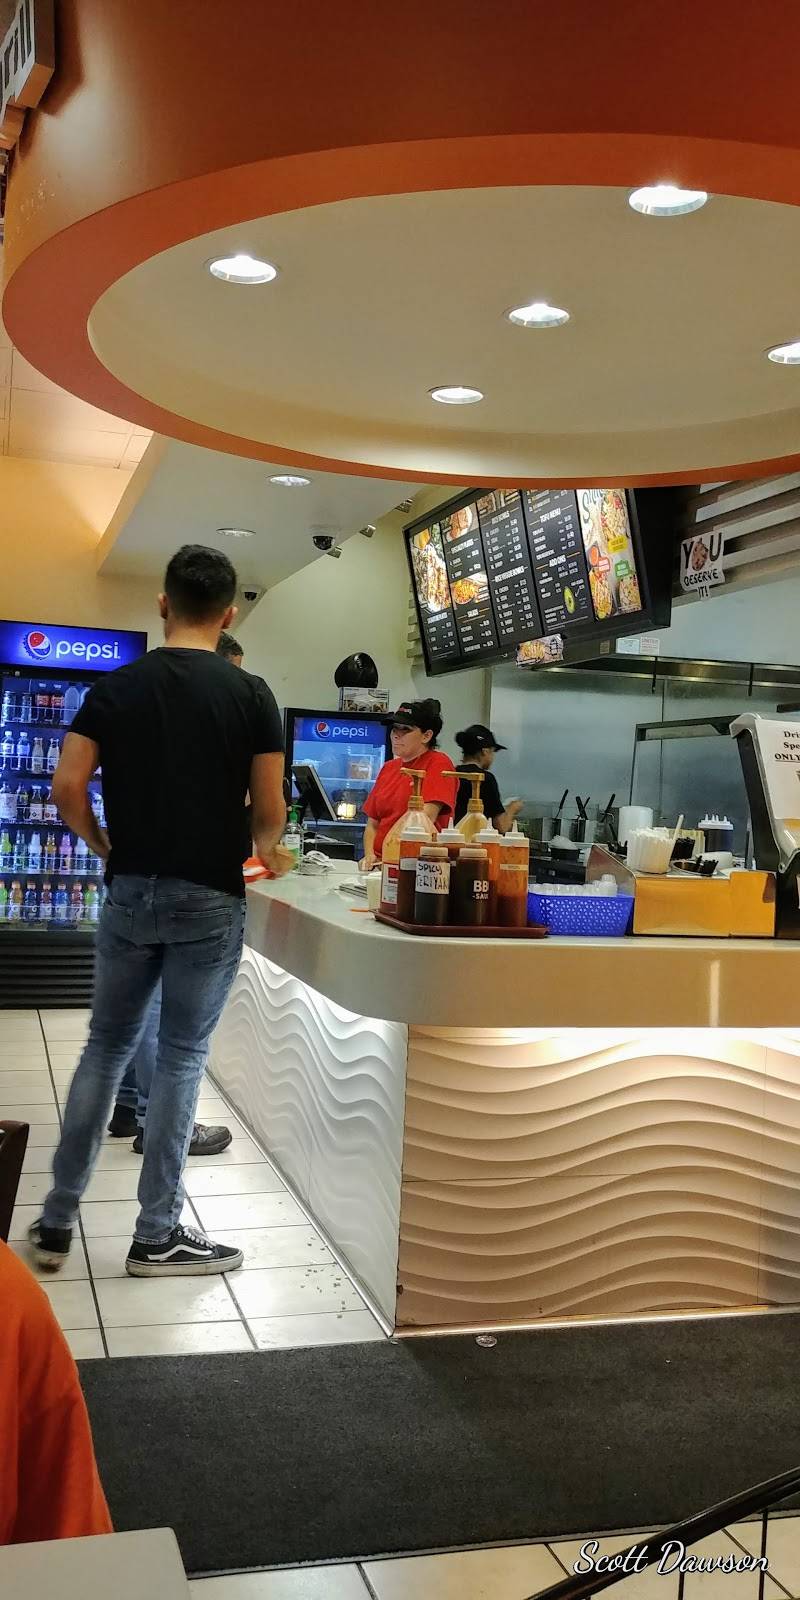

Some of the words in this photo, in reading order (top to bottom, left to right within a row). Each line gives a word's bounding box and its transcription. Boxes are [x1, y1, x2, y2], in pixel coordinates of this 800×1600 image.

[684, 569, 719, 586] DESERVE
[697, 585, 709, 598] IT!
[55, 641, 119, 661] pepsi
[332, 726, 368, 738] pepsi
